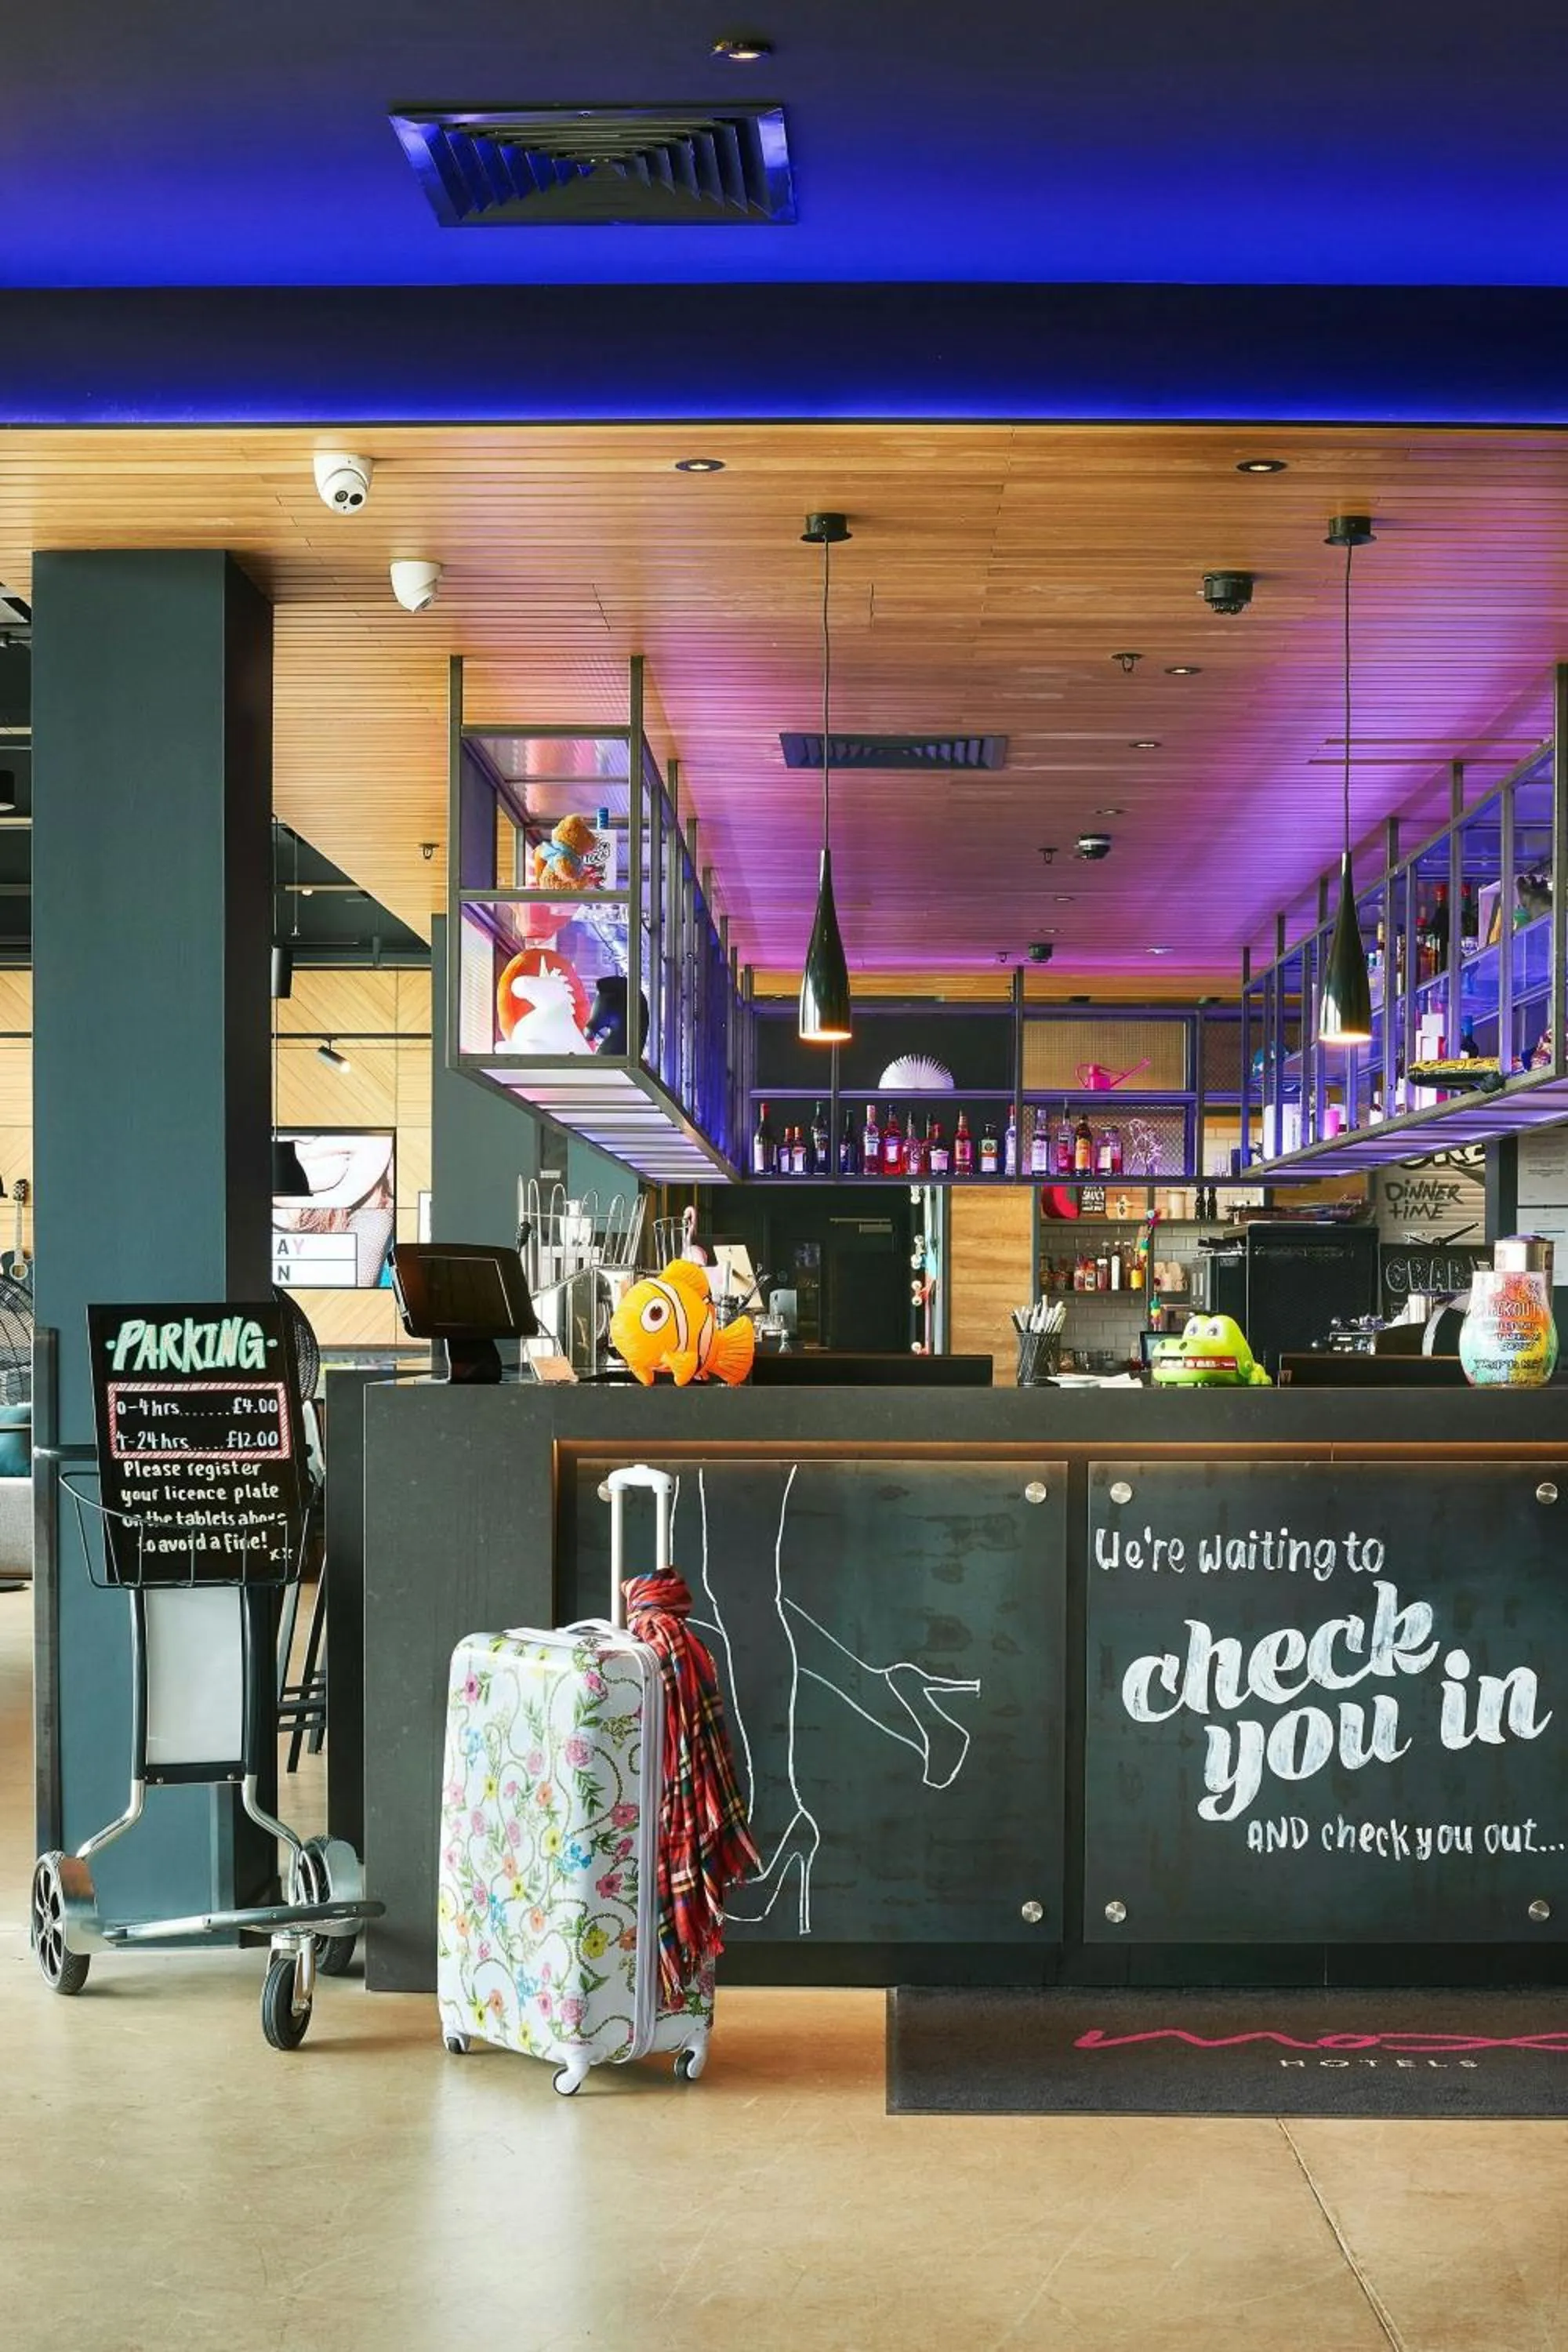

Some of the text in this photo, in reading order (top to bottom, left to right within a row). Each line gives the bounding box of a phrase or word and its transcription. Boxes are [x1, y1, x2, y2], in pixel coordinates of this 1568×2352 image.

[112, 1316, 266, 1373] PARKING
[123, 1459, 262, 1482] Please register
[120, 1481, 280, 1508] your licence plate
[176, 1509, 236, 1526] tablets
[158, 1533, 207, 1553] avoid
[209, 1535, 222, 1550] a
[1094, 1526, 1386, 1581] We're waiting to
[1120, 1579, 1441, 1723] check
[1196, 1648, 1554, 1822] you in
[1246, 1816, 1309, 1853] AND
[1320, 1813, 1411, 1861] check
[1414, 1826, 1473, 1860] you
[1279, 2059, 1479, 2068] HOTELS
